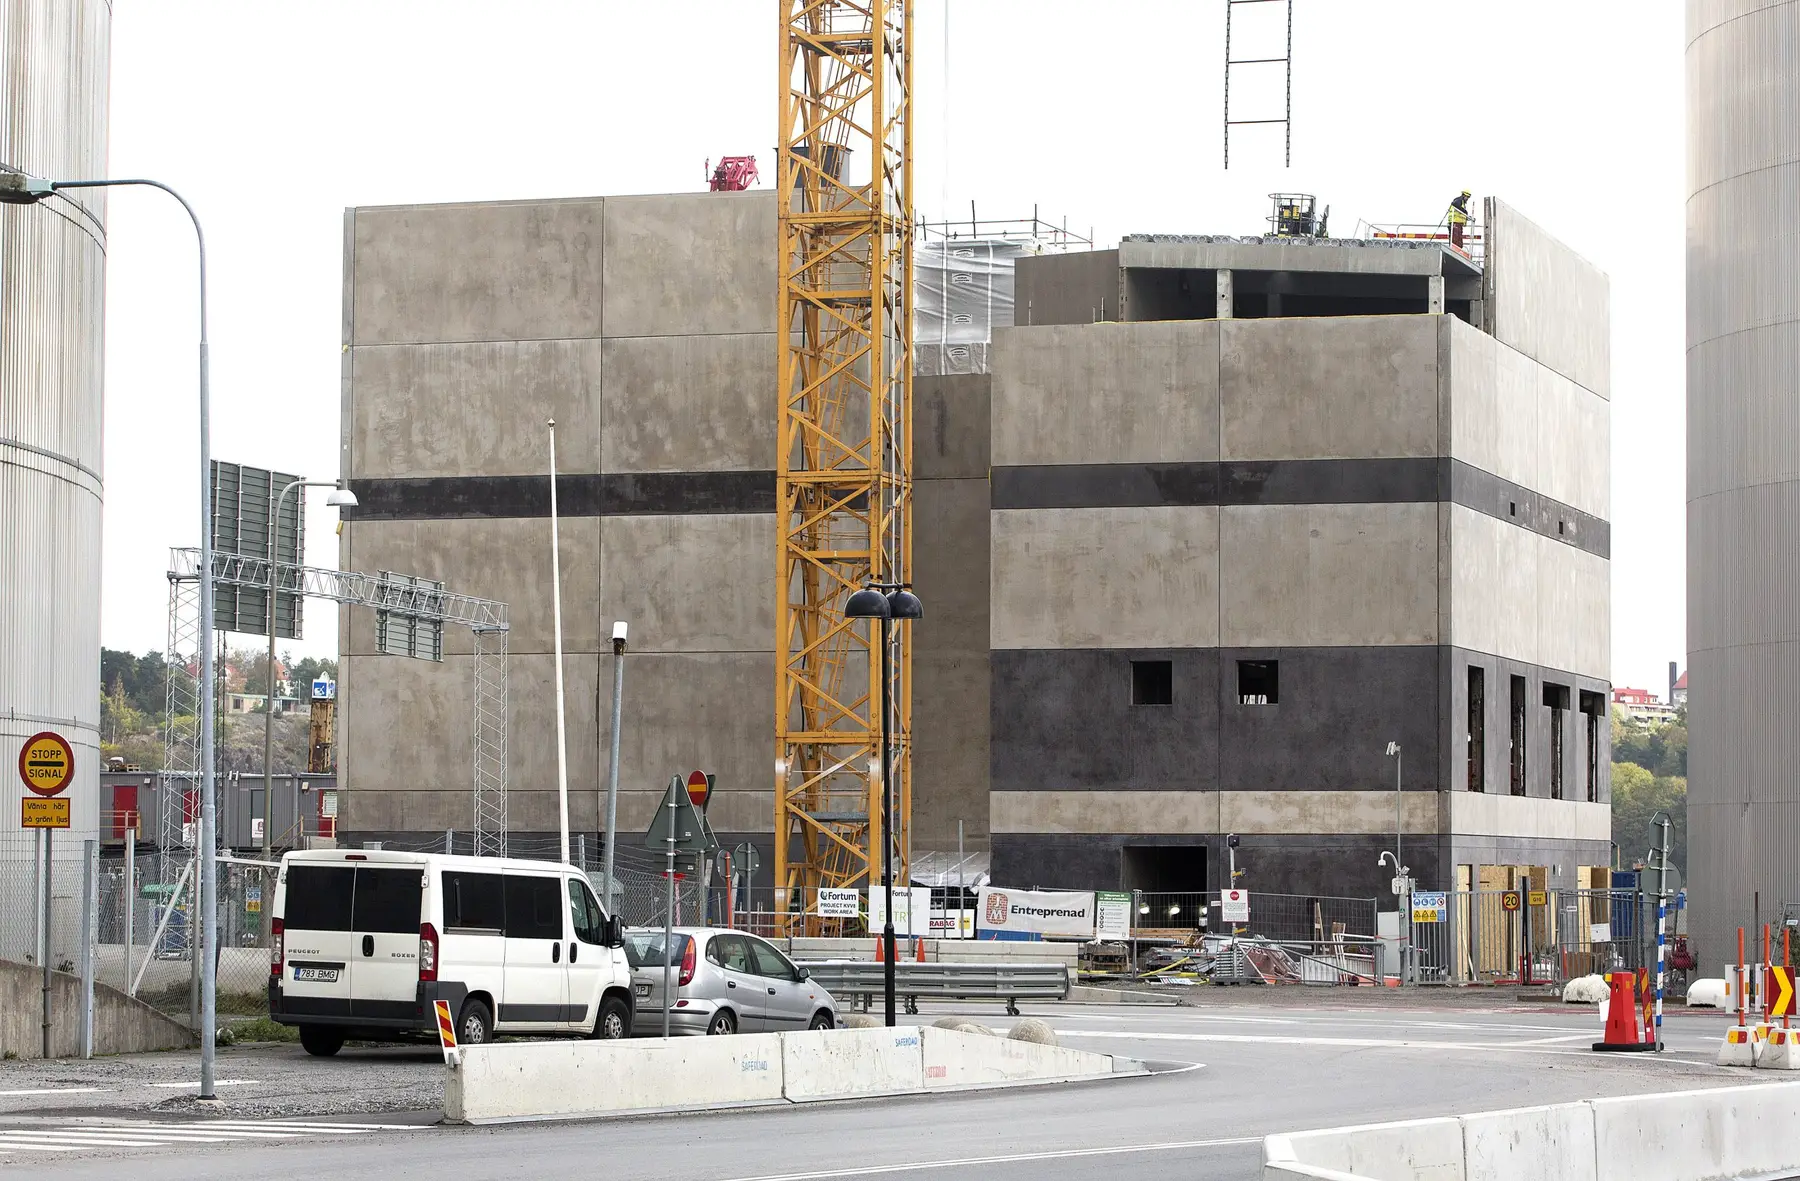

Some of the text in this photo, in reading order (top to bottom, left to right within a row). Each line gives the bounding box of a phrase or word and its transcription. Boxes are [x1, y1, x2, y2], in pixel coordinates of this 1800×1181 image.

[31, 749, 62, 759] STOPP
[29, 769, 63, 778] SIGNAL
[27, 802, 65, 810] Vänta här
[35, 815, 53, 824] grönt
[56, 815, 68, 824] ljus
[828, 891, 857, 900] Fortum
[1505, 896, 1517, 906] 20
[878, 910, 913, 922] ETR
[1011, 905, 1085, 918] Entreprenad
[301, 969, 315, 978] 783
[317, 970, 335, 979] BMG
[895, 1036, 918, 1047] SAFEROAD
